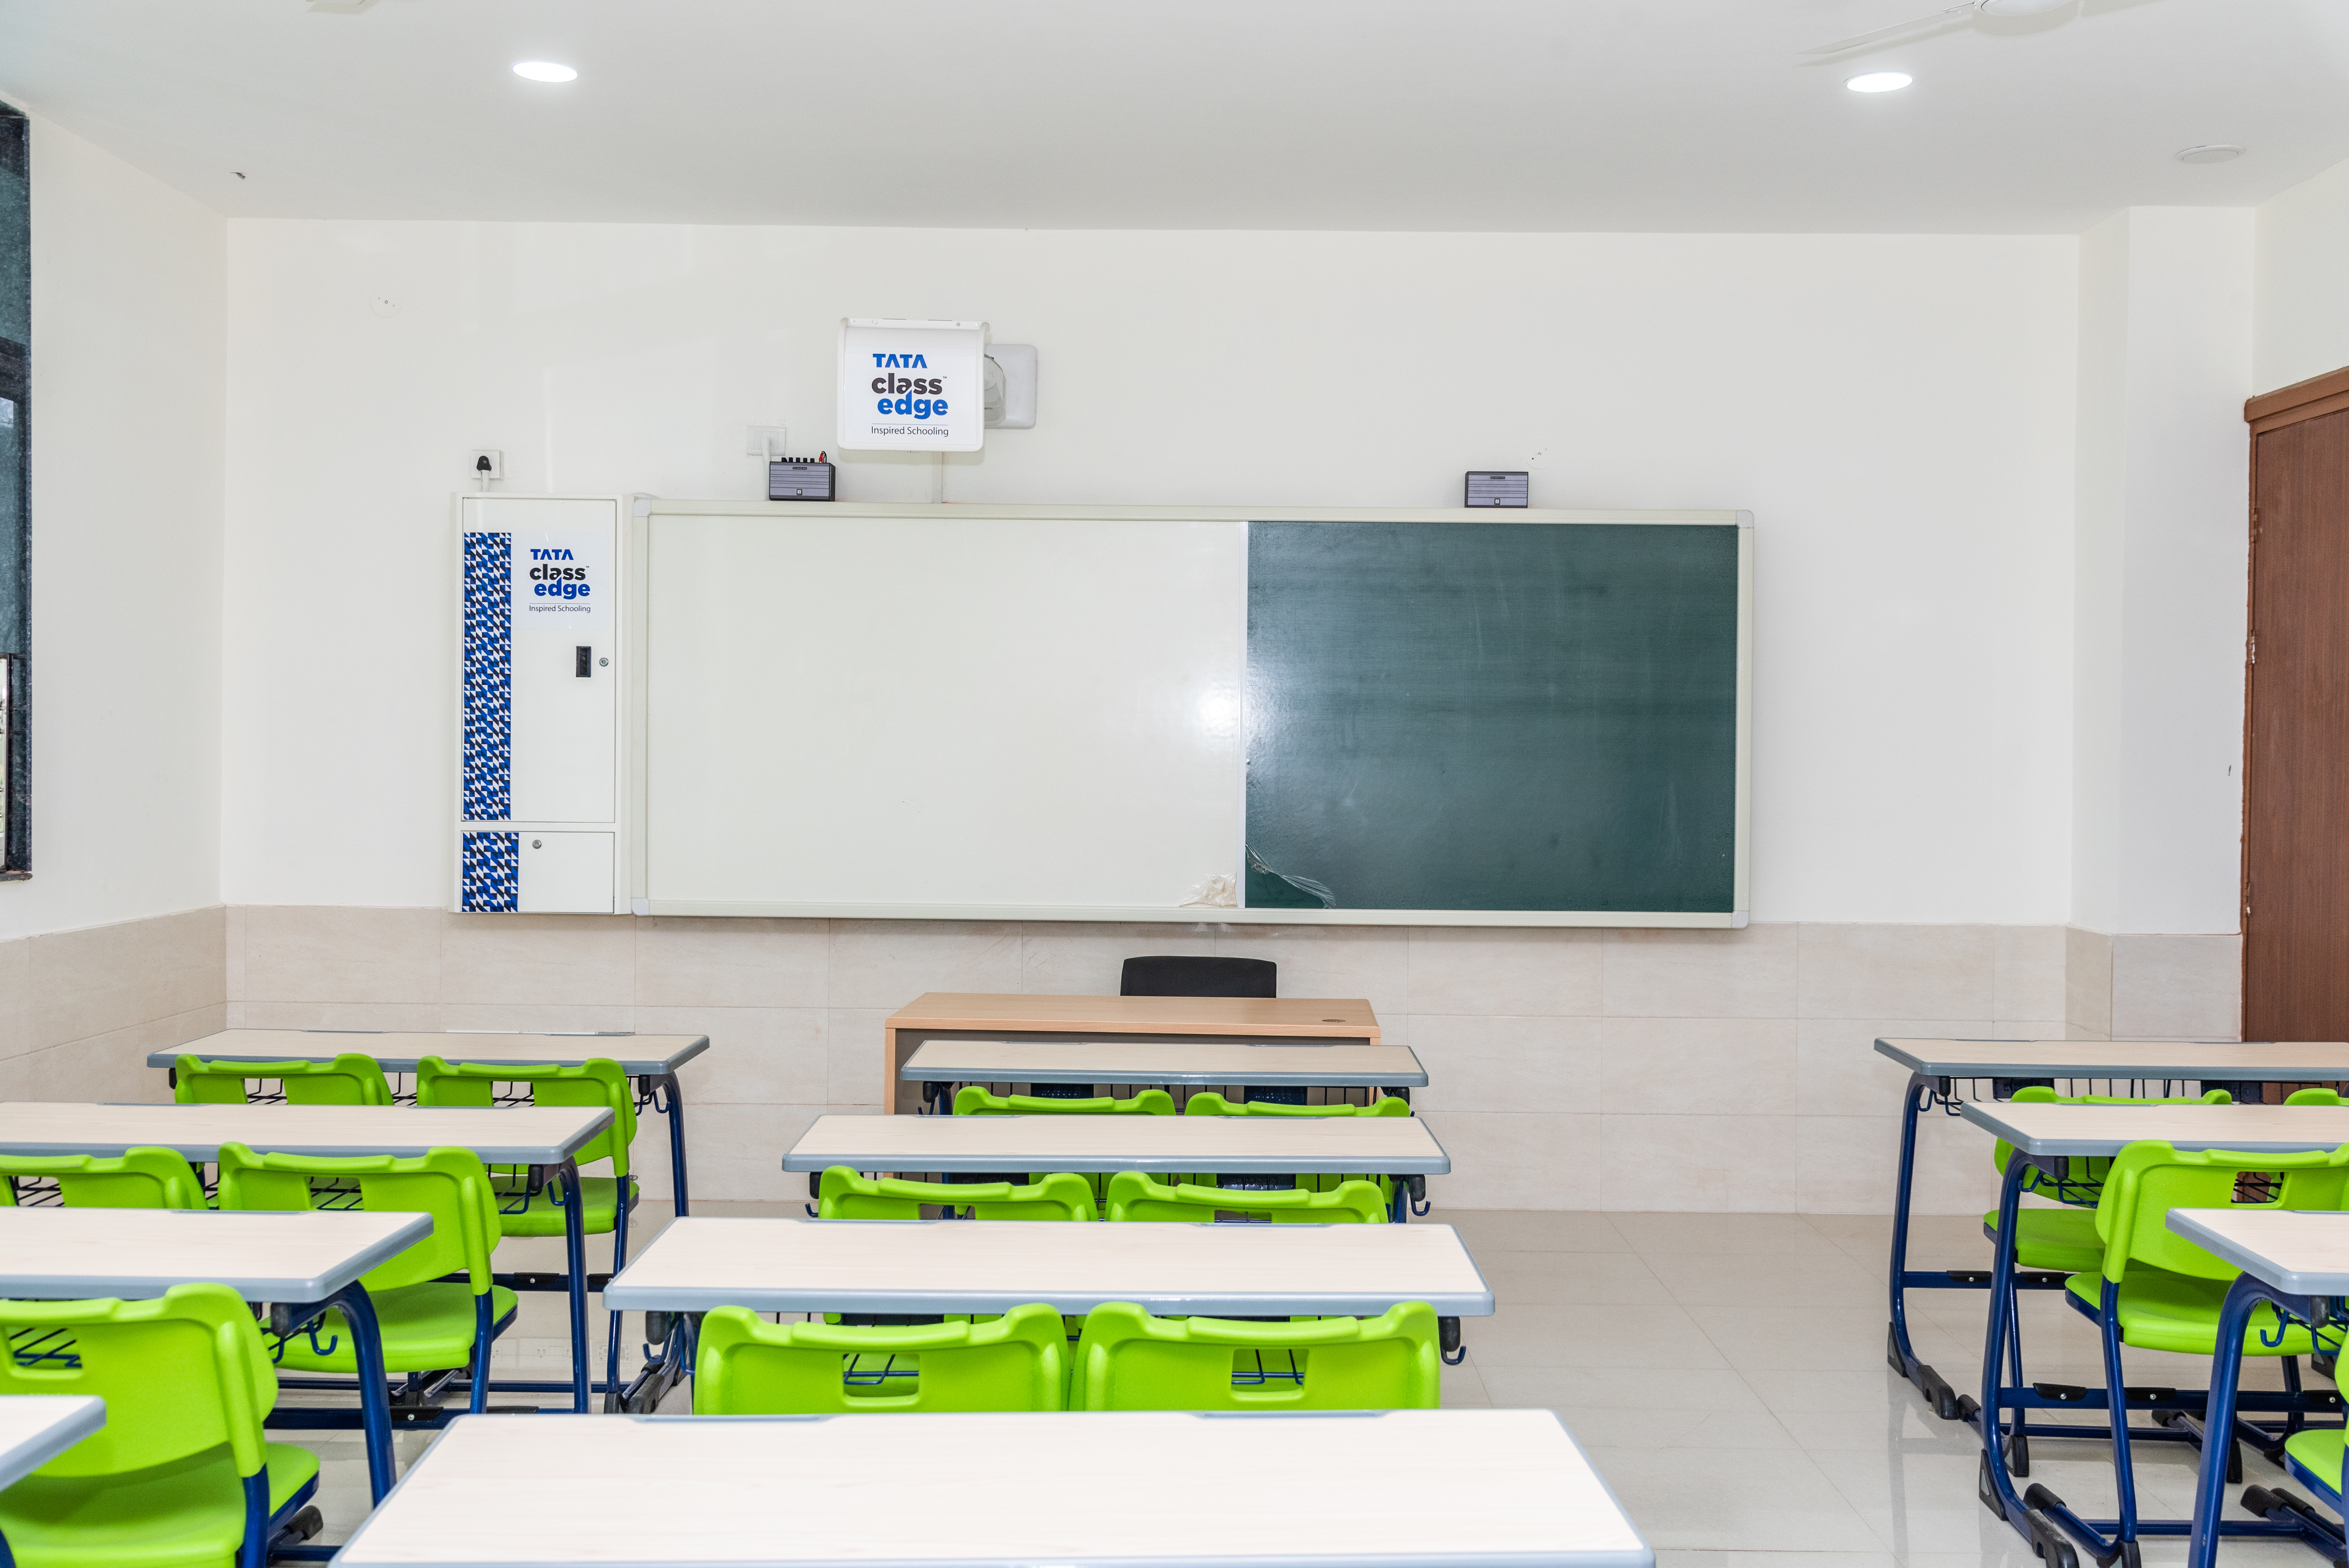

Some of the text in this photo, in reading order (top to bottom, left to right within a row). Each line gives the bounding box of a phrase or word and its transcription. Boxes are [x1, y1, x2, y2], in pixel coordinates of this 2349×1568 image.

[872, 353, 928, 369] TATA
[872, 372, 943, 395] class
[877, 389, 948, 420] edge
[872, 426, 949, 437] Inspired Schooling
[530, 549, 574, 560] TATA
[529, 563, 586, 581] class
[534, 576, 590, 600] edge
[558, 605, 591, 613] Schooling
